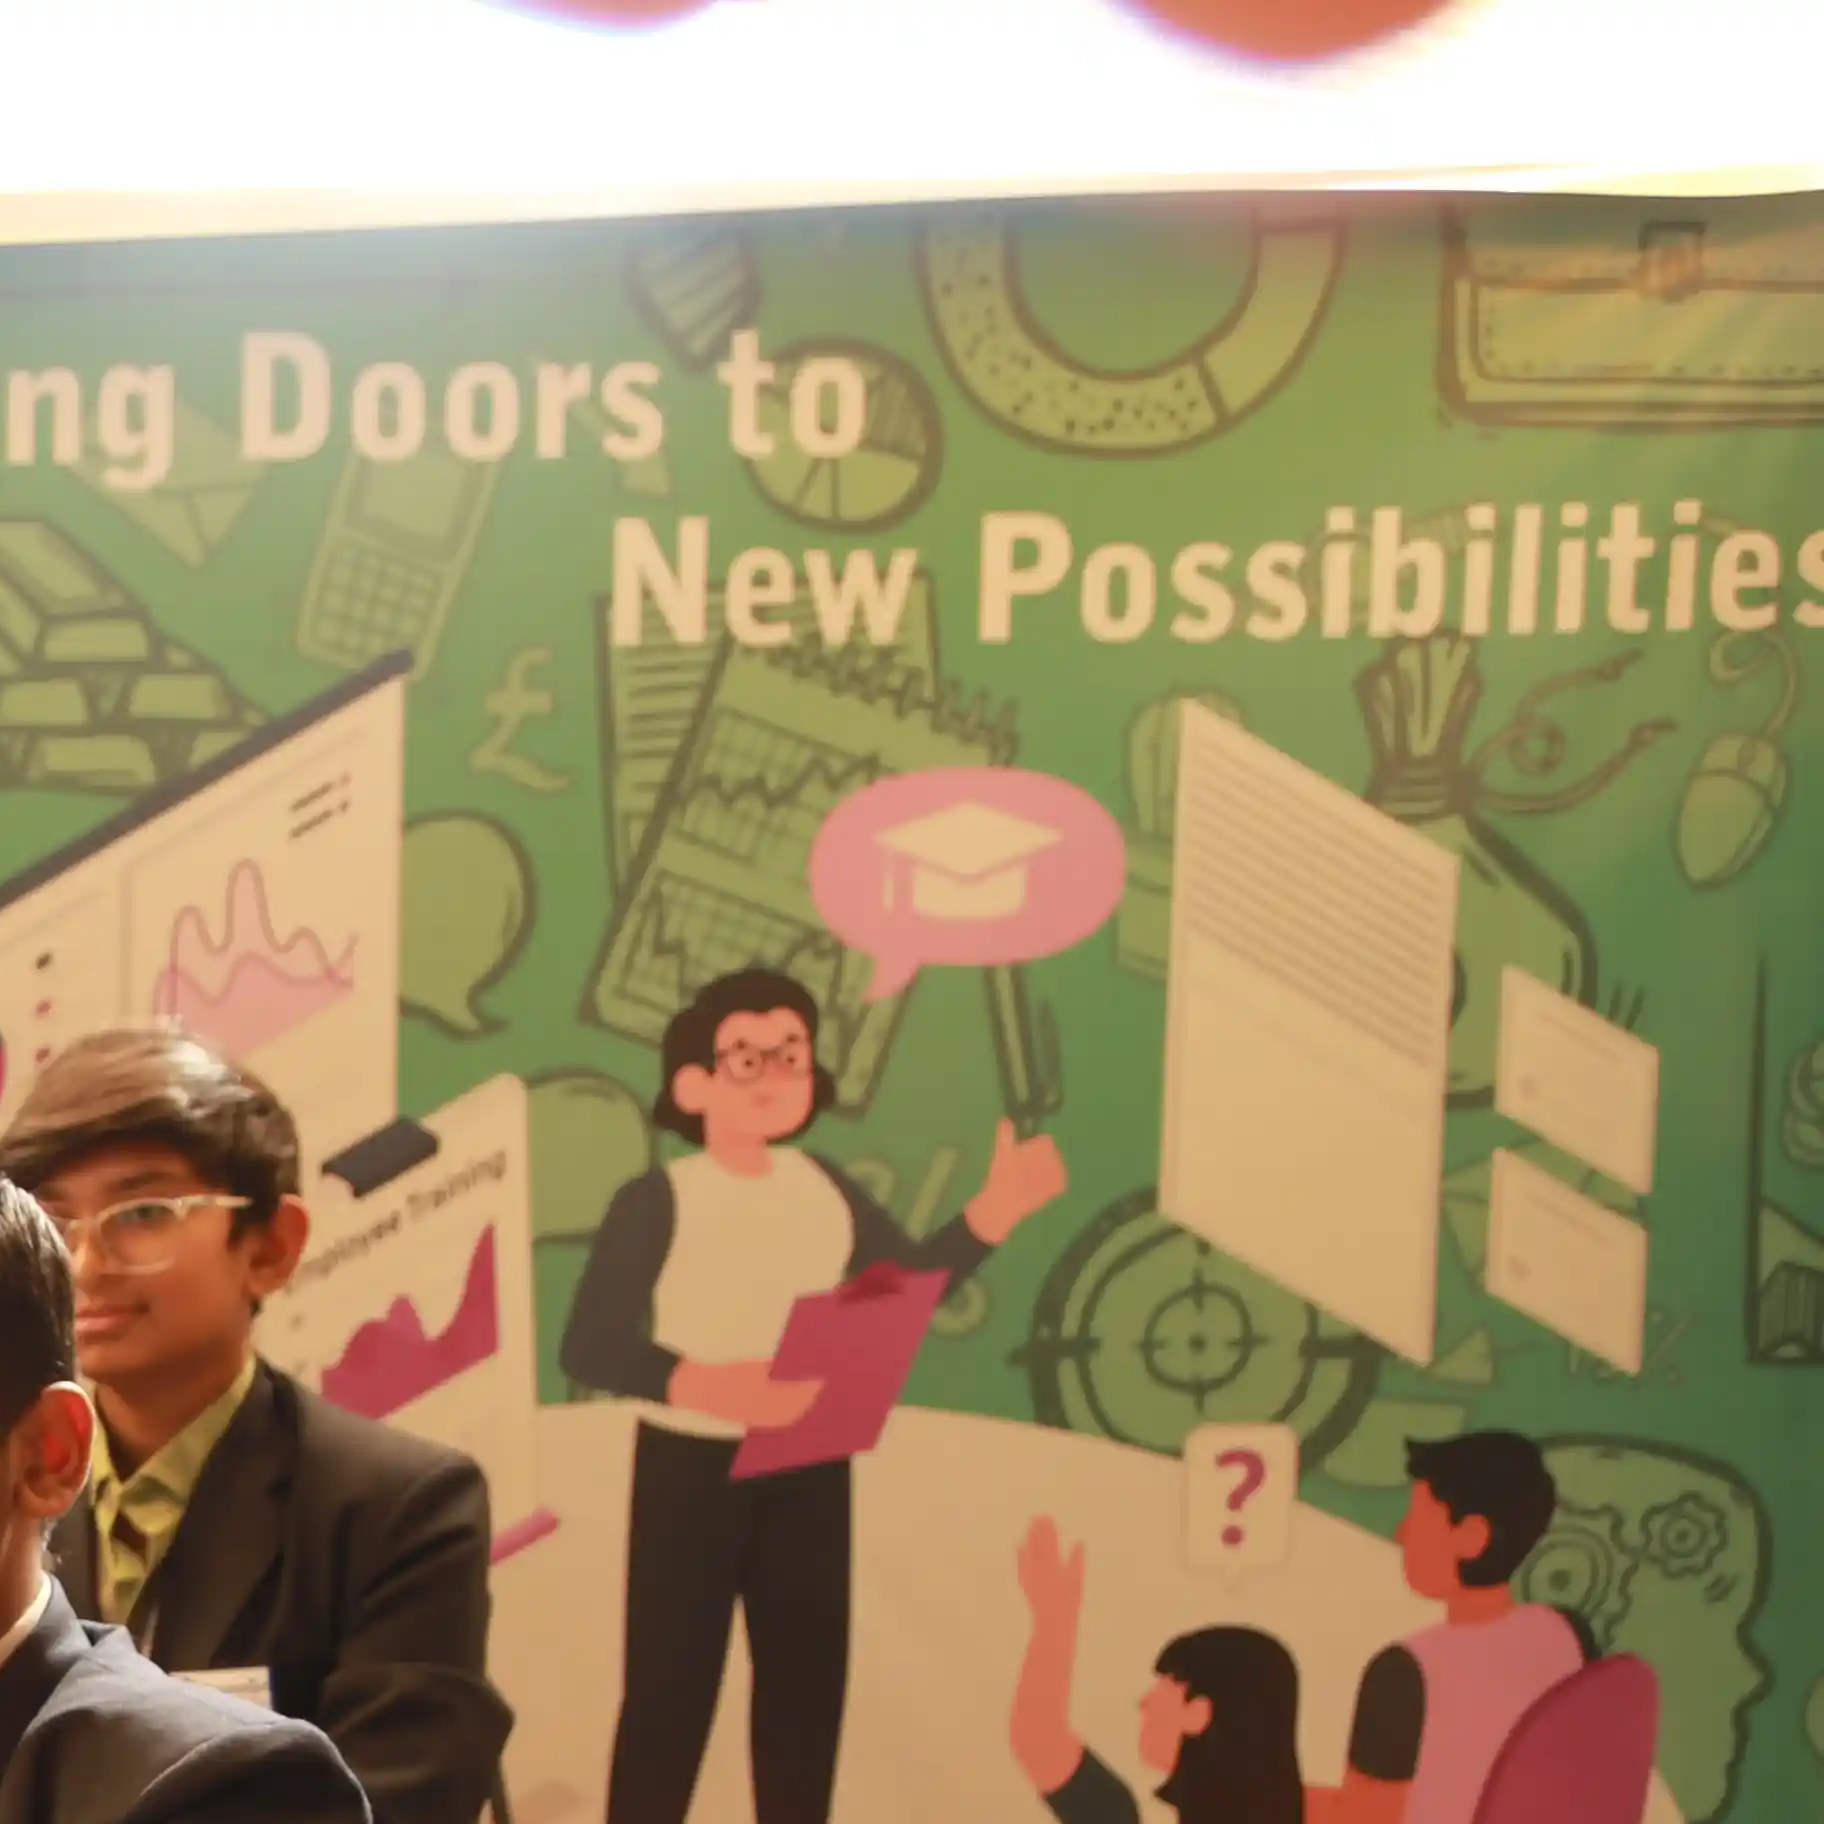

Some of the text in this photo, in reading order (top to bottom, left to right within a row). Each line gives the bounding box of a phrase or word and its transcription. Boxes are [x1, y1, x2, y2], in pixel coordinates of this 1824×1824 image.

[240, 331, 666, 461] Doors
[718, 328, 866, 460] to
[609, 514, 919, 647] New
